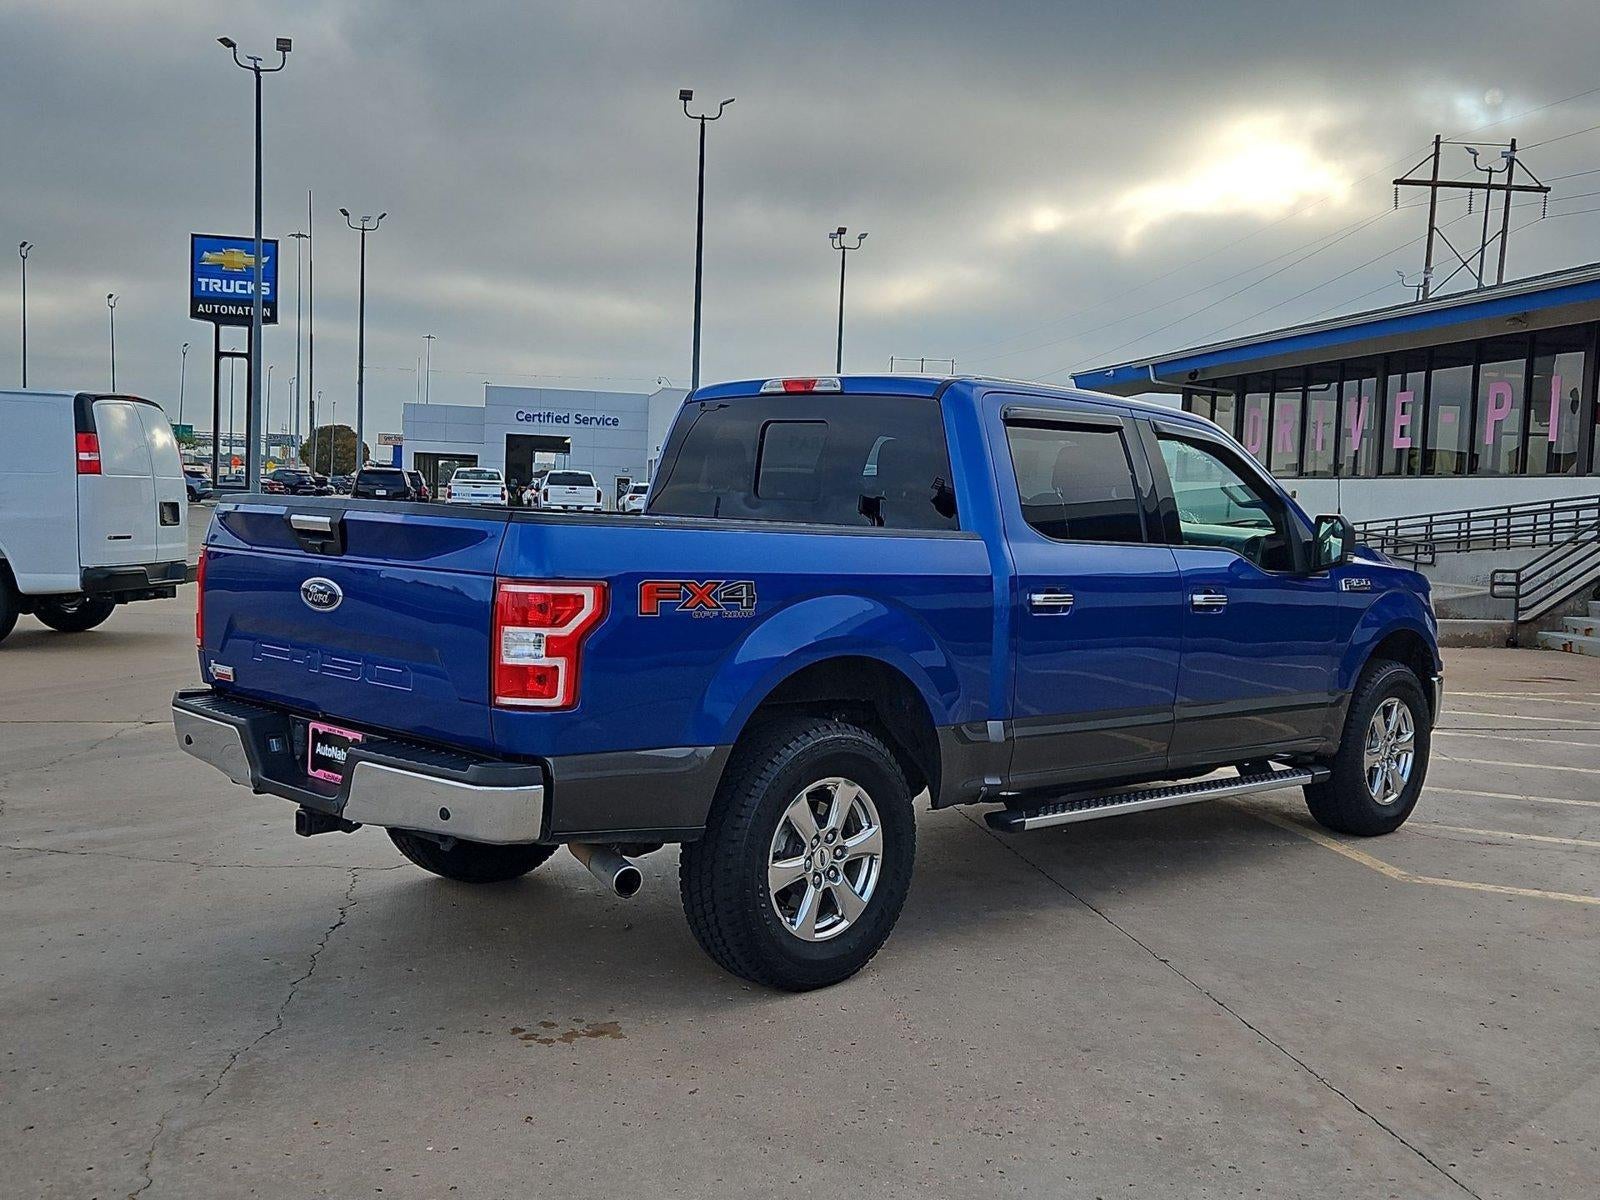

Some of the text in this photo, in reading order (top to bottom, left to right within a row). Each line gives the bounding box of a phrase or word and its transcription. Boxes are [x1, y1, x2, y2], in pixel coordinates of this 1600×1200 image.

[198, 278, 271, 295] TRUCKS
[197, 303, 271, 317] AUTONATIN
[515, 410, 620, 427] Certified Service
[638, 580, 756, 616] FX4
[253, 640, 413, 692] F-150
